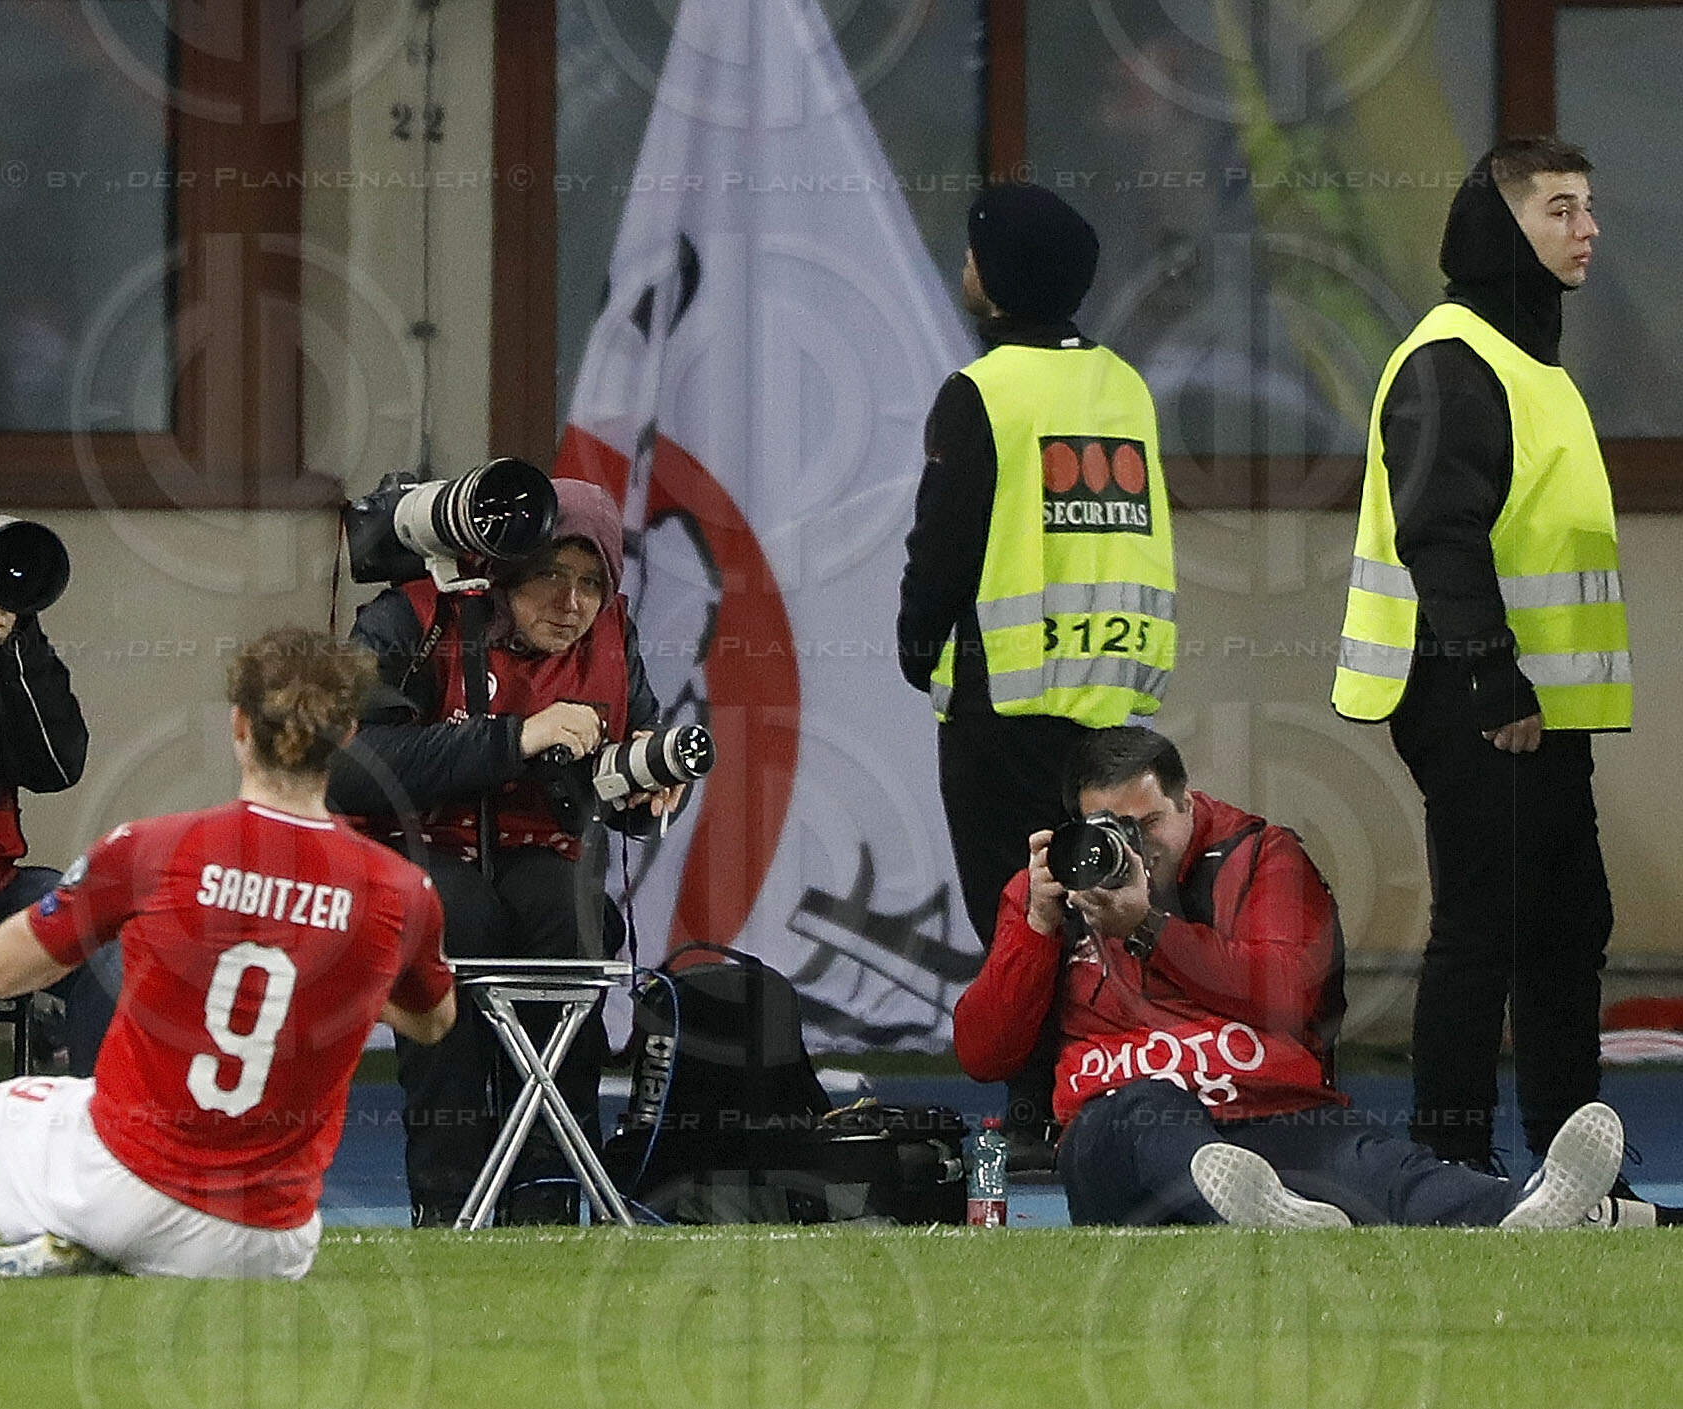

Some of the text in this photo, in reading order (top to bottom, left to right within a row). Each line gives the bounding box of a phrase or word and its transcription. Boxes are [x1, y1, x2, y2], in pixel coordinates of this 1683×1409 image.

[390, 103, 445, 142] 22
[1043, 501, 1147, 526] SECURITAS
[196, 863, 354, 932] SABITZER
[186, 940, 298, 1118] 9
